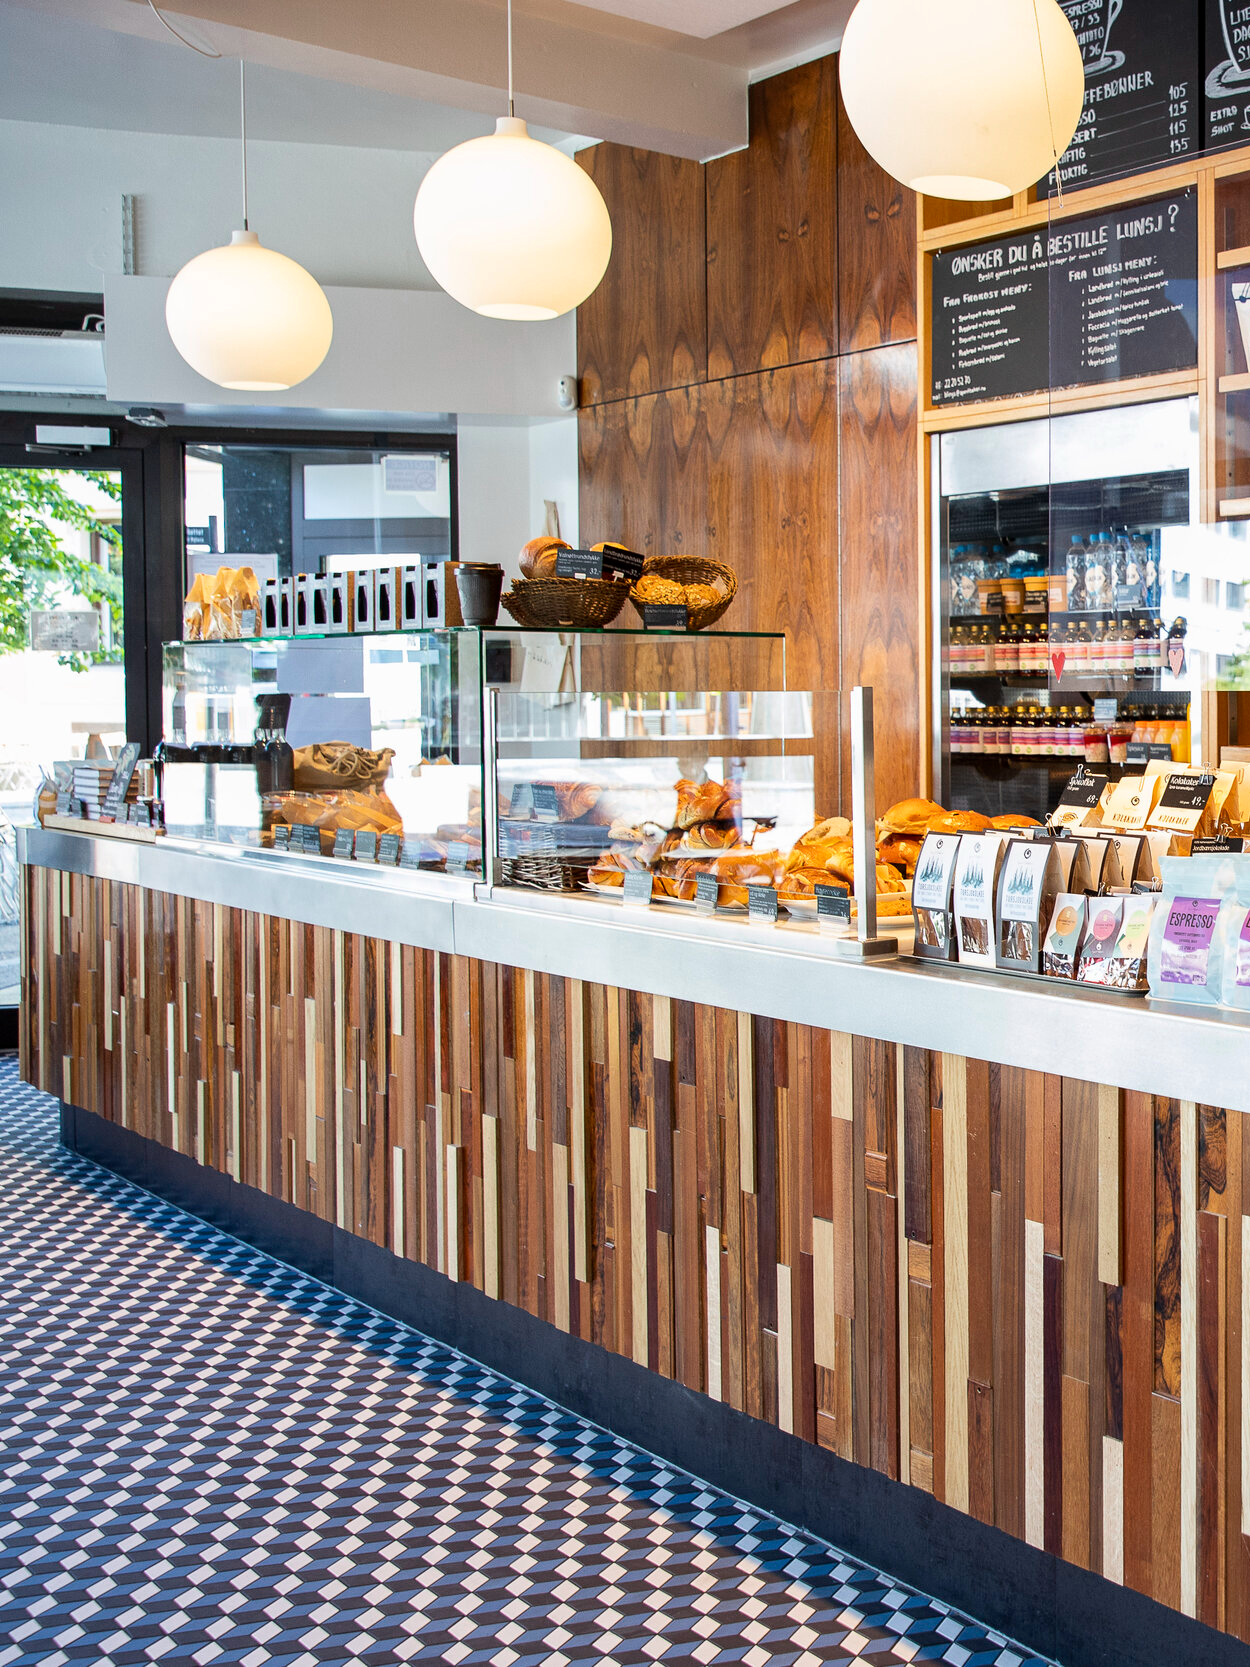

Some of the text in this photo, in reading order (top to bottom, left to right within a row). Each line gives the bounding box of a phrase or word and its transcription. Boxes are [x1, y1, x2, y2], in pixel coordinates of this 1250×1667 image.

[1077, 26, 1105, 46] CHIATO
[1084, 71, 1154, 105] FFEBØNNER
[1168, 82, 1189, 101] 105
[1069, 100, 1189, 146] SERT 125
[1209, 105, 1238, 122] EXTRA
[1169, 120, 1188, 136] 115
[1211, 122, 1235, 137] SHOT
[952, 248, 1003, 276] ØNSKER
[1009, 245, 1027, 264] DU
[1032, 234, 1043, 259] Å
[1047, 226, 1109, 256] BESTILLE
[1116, 215, 1163, 241] LUNSJ
[1069, 256, 1157, 282] FRA LUNSJ MENY:
[1169, 912, 1213, 929] ESPRESSO
